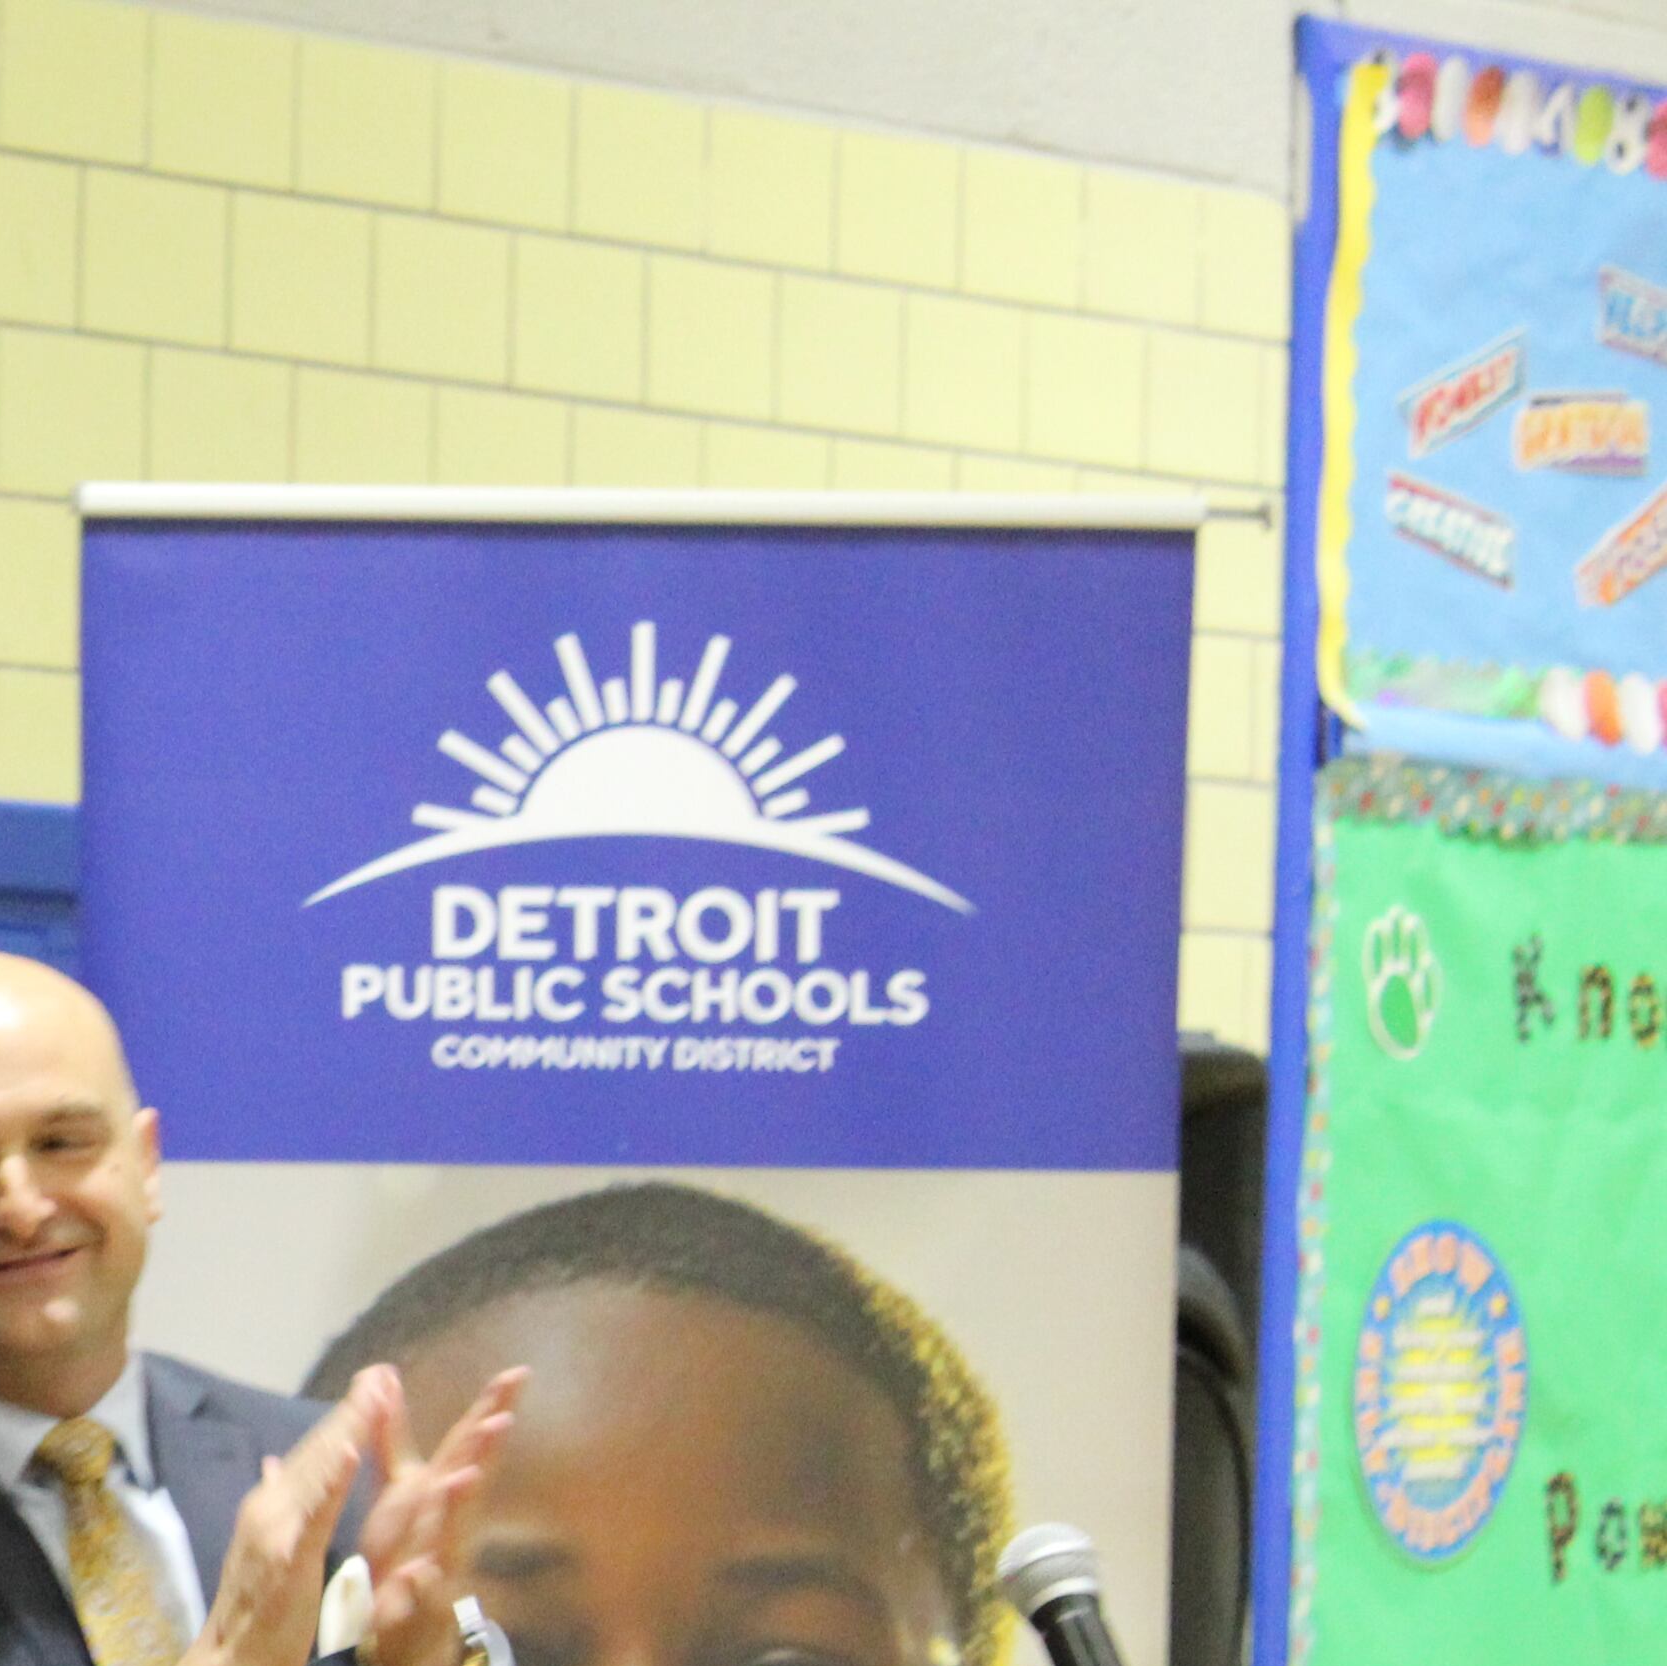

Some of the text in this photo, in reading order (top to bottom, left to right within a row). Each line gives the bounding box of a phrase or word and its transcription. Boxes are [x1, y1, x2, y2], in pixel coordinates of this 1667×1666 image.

[432, 885, 841, 964] DETROIT
[341, 964, 930, 1026] PUBLIC SCHOOLS
[431, 1034, 840, 1073] COMMUNITY DISTRICT
